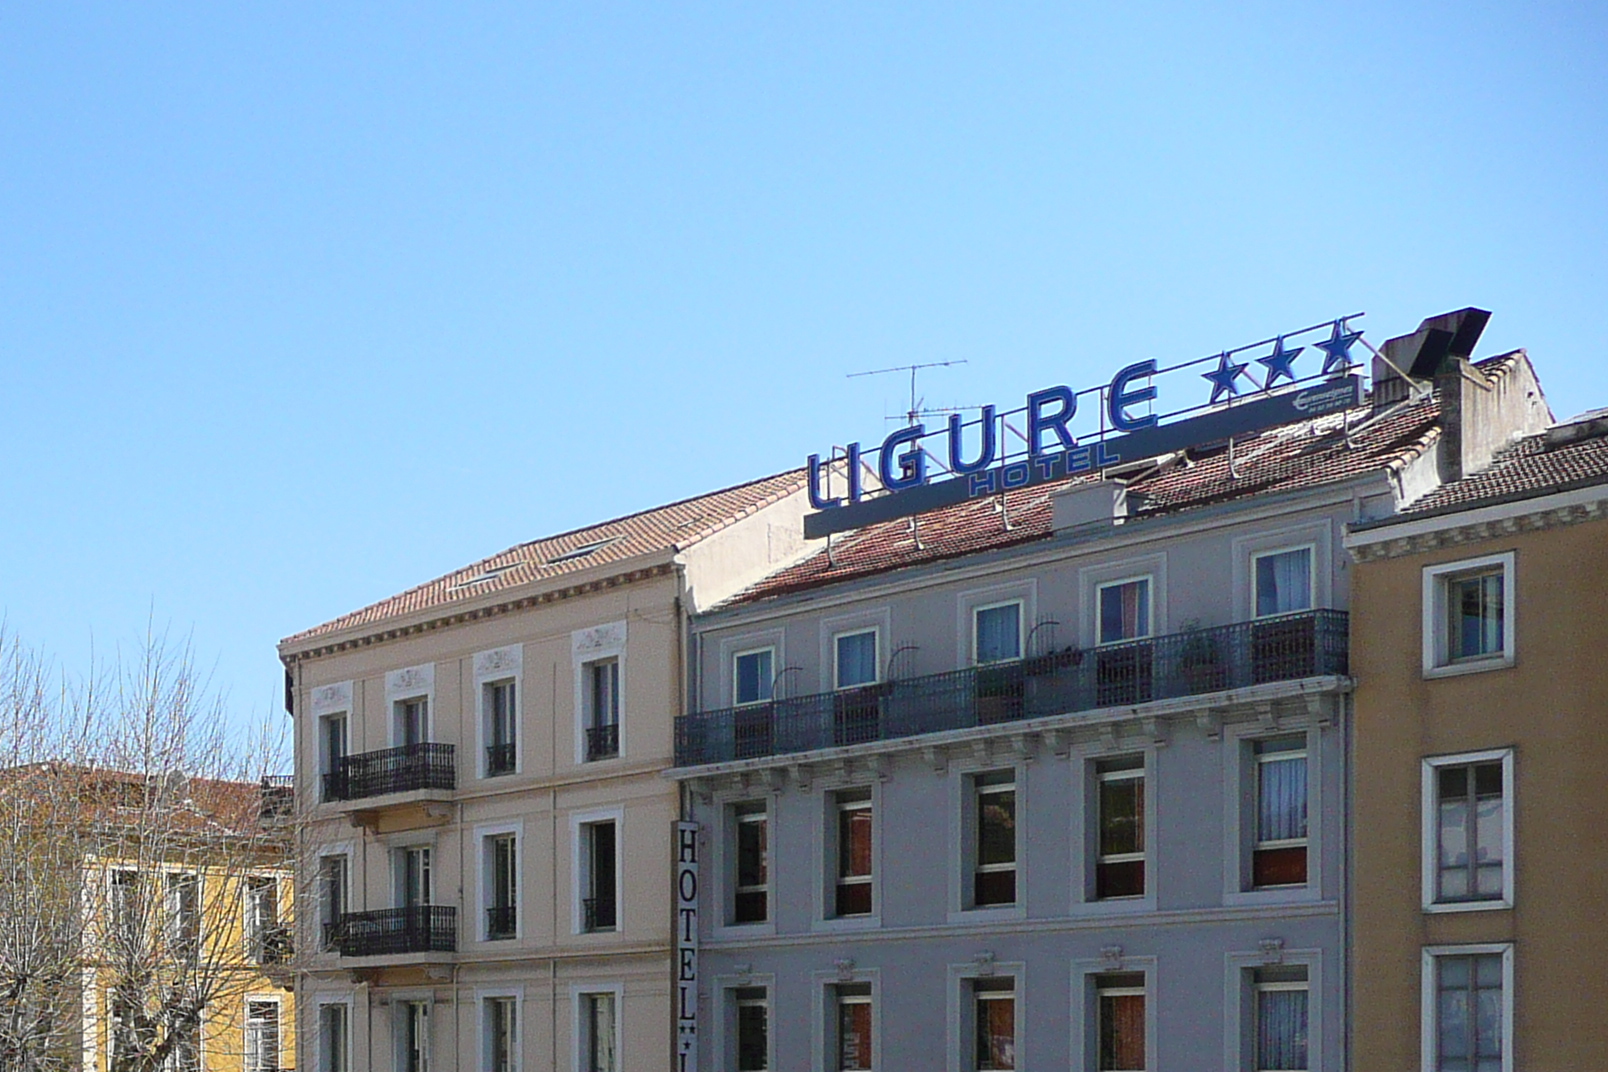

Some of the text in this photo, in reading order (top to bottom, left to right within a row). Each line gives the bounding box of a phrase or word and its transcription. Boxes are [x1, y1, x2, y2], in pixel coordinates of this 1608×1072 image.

[807, 358, 1158, 510] LIGURE
[969, 442, 1120, 497] HOTEL
[679, 829, 696, 1023] HOTEL
